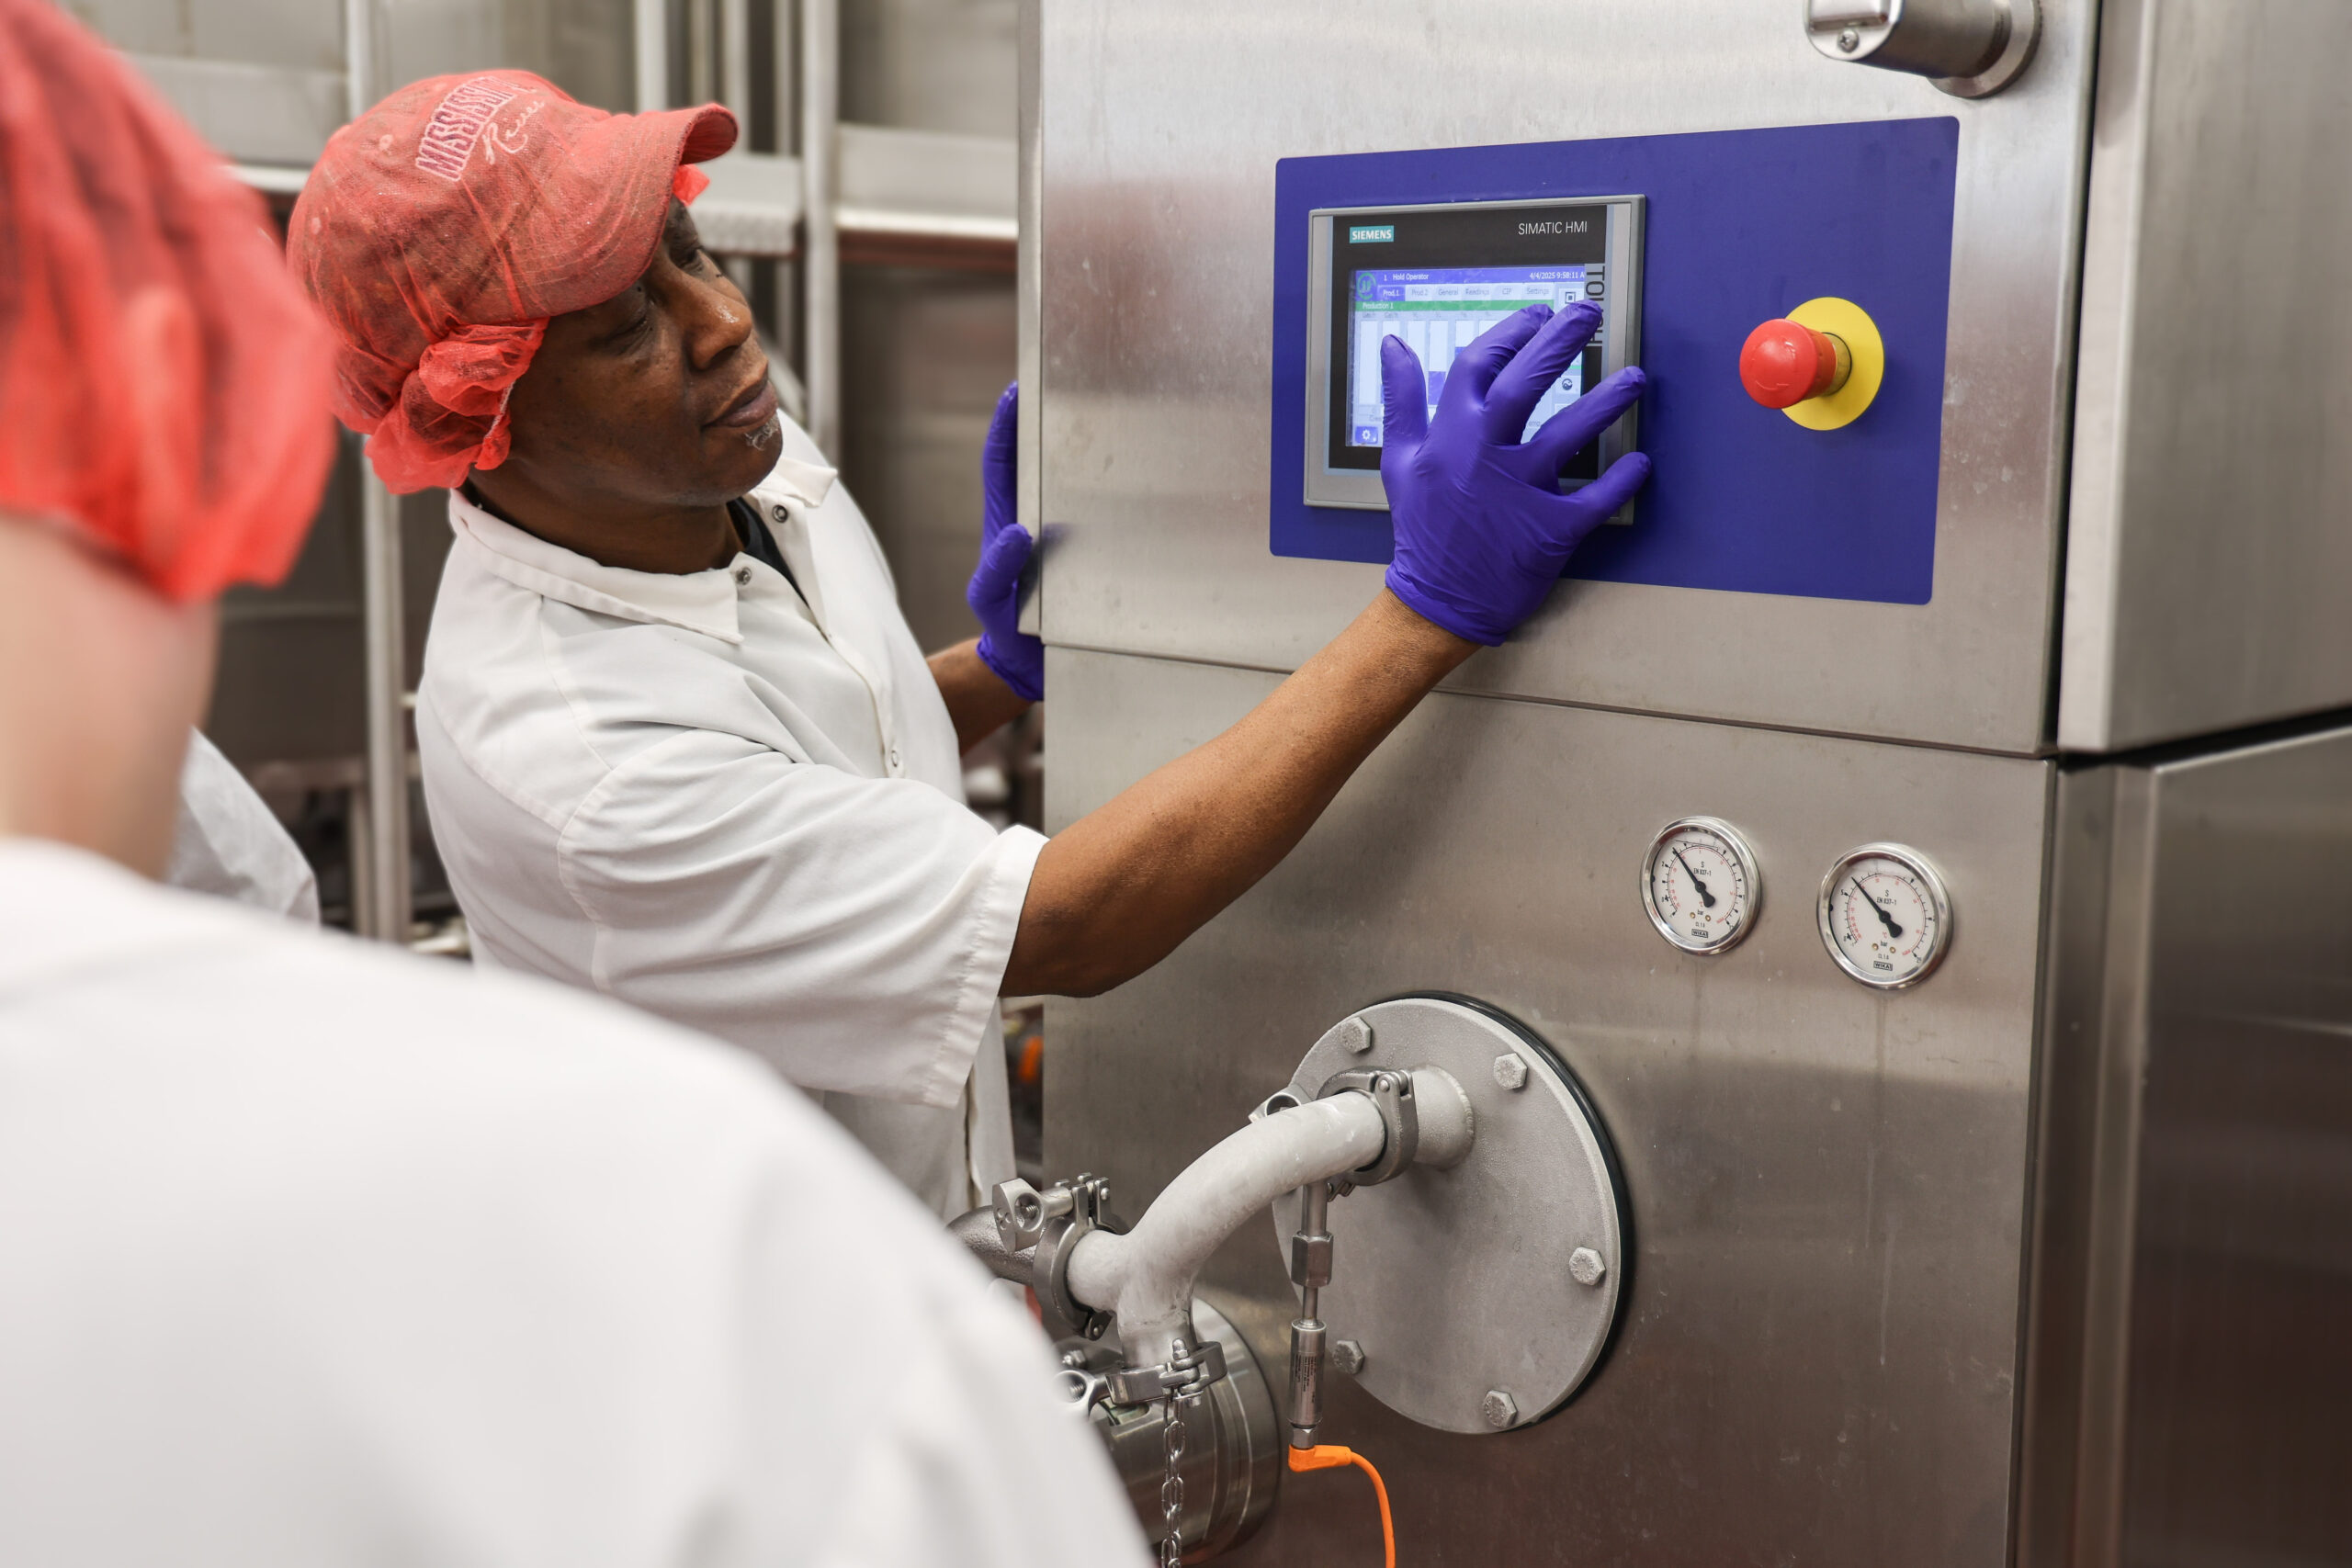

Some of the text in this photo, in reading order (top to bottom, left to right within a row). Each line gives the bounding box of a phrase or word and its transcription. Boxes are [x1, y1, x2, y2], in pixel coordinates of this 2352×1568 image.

[1518, 220, 1588, 235] SIMATIC HMI
[1351, 229, 1392, 241] SIEMENS
[1392, 273, 1406, 281] Hold
[1406, 273, 1429, 282] Operator
[1529, 272, 1555, 280] 4/4/2025
[1438, 288, 1458, 296] General
[1526, 287, 1550, 296] Settings
[1586, 265, 1605, 344] TOH
[1692, 929, 1707, 937] WIKA
[1875, 962, 1892, 970] WIKA
